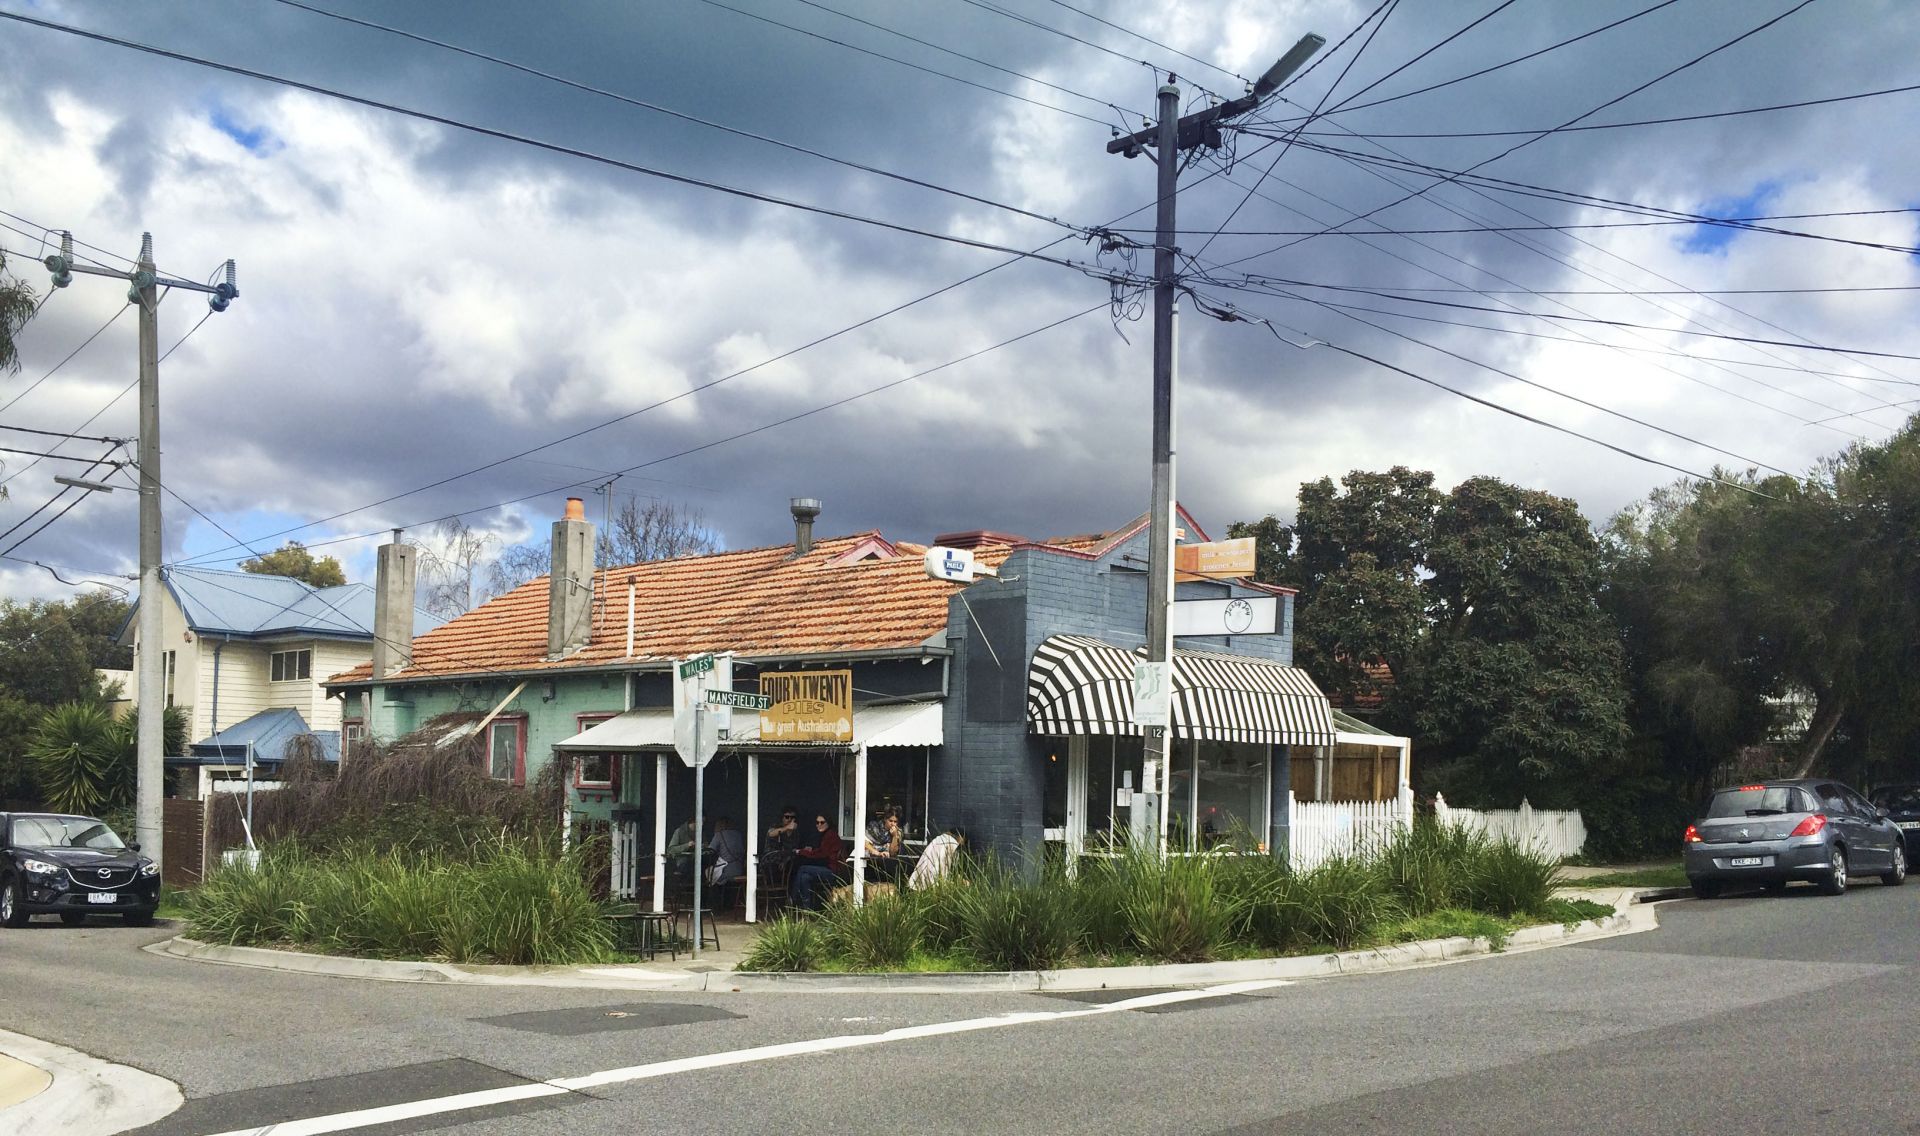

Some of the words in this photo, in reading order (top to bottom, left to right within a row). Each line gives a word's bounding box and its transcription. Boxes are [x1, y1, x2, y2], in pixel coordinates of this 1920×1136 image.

[684, 658, 709, 677] WALES
[709, 691, 755, 708] MANSFIELD
[758, 697, 768, 709] ST
[802, 674, 848, 710] TWENTY
[782, 700, 825, 715] PIES
[777, 719, 795, 737] great
[797, 718, 836, 733] Australian
